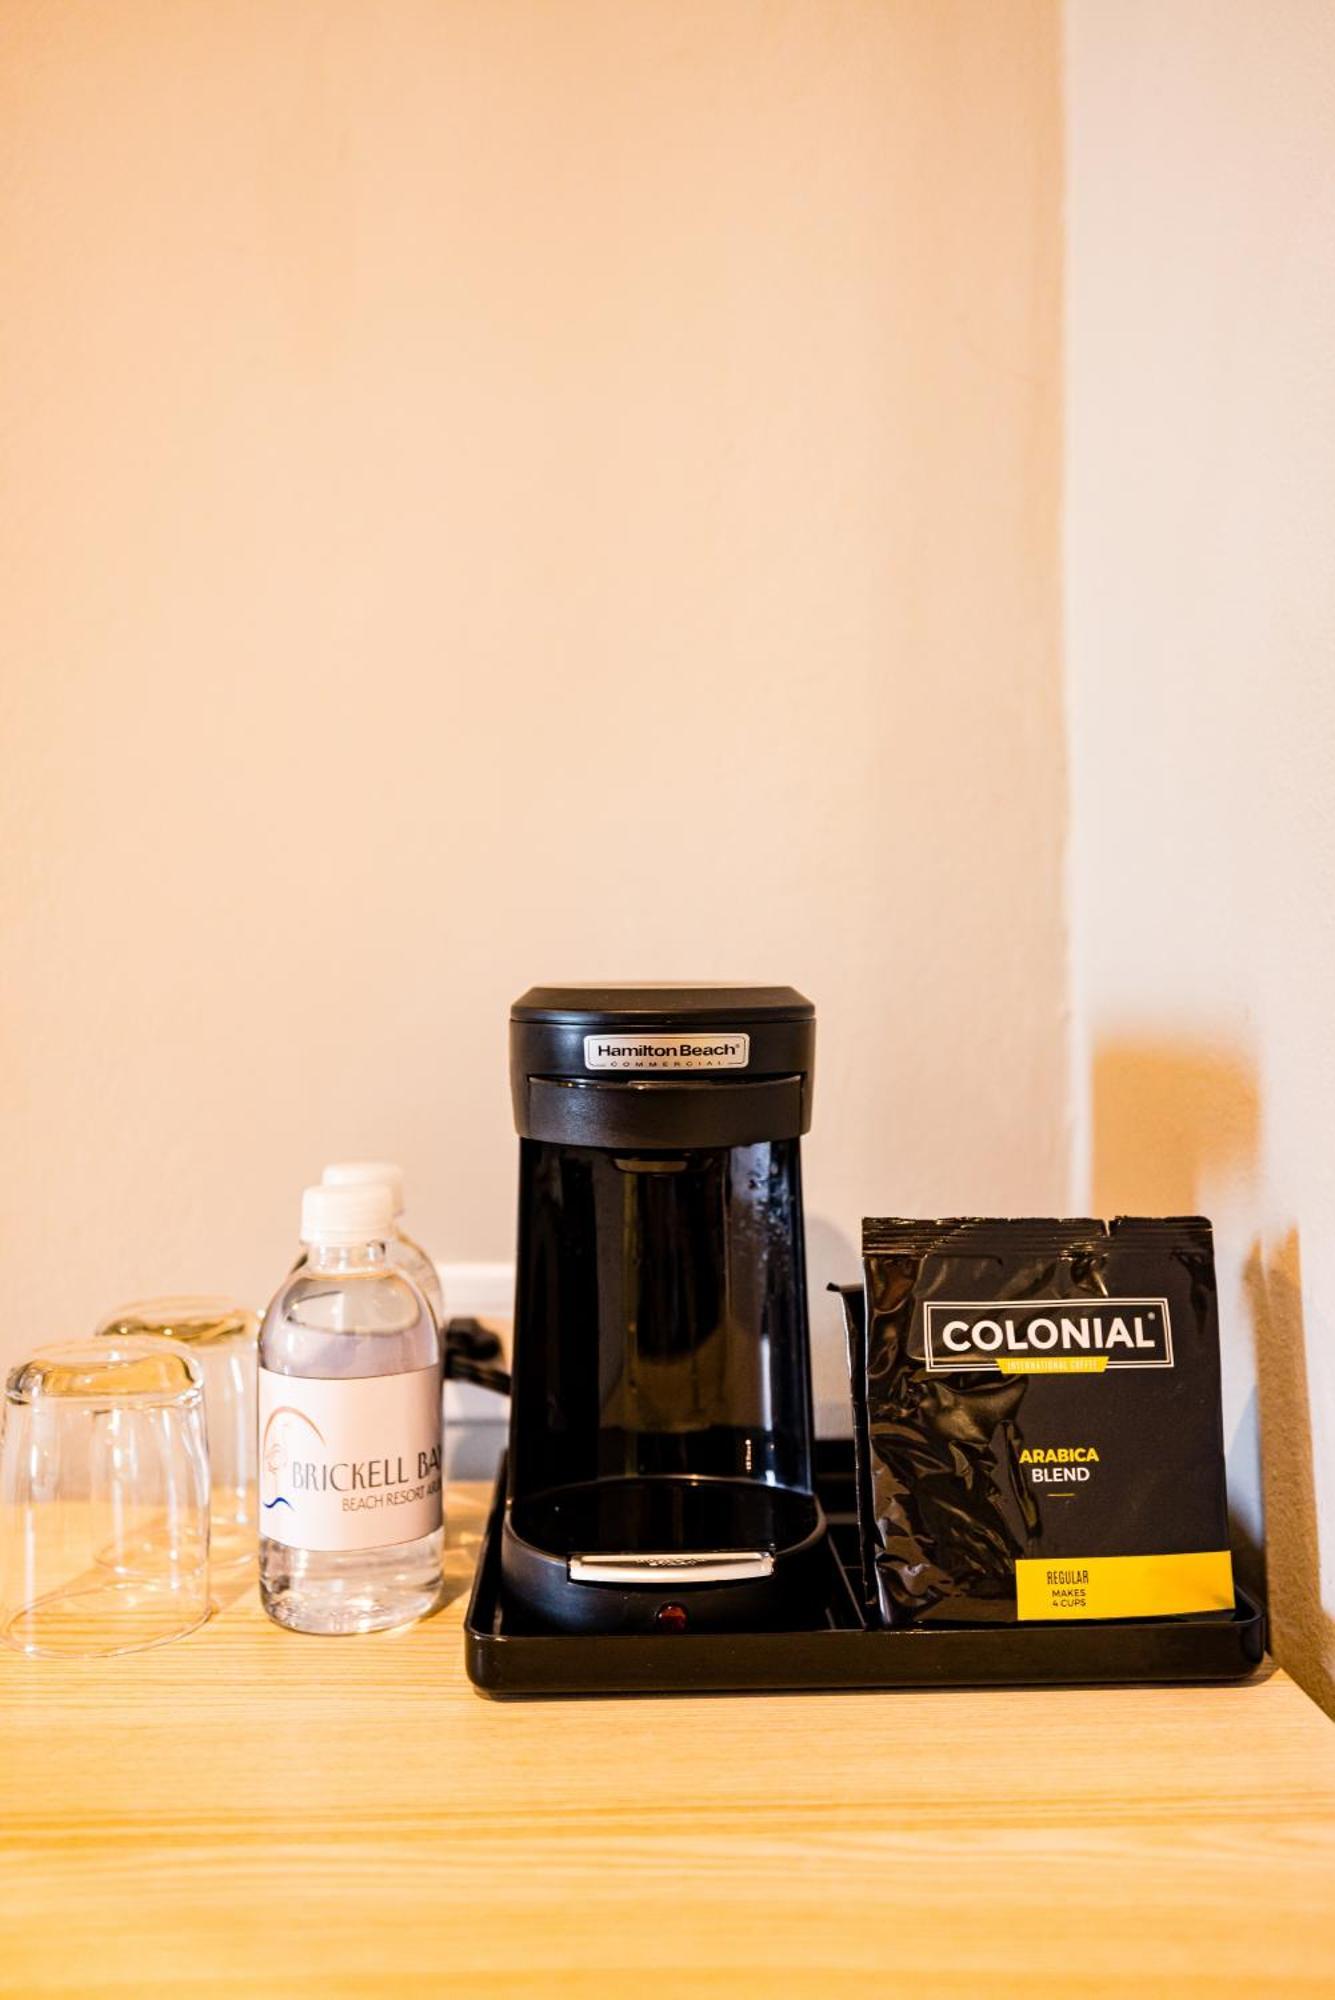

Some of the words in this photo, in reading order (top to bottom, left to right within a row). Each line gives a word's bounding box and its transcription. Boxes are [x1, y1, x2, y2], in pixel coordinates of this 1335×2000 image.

[598, 1044, 678, 1057] Hamilton
[610, 1060, 723, 1068] COMMERCIAL
[942, 1316, 1156, 1352] COLONIAL
[1019, 1447, 1100, 1464] ARABICA
[292, 1456, 409, 1493] BRICKELL
[1031, 1467, 1090, 1483] BLEND
[342, 1492, 384, 1512] BEACH
[386, 1484, 425, 1506] RESORT
[1046, 1570, 1089, 1585] REGULAR
[1051, 1588, 1087, 1598] MAKES
[1052, 1600, 1059, 1608] 4
[1060, 1599, 1087, 1608] CUPS
